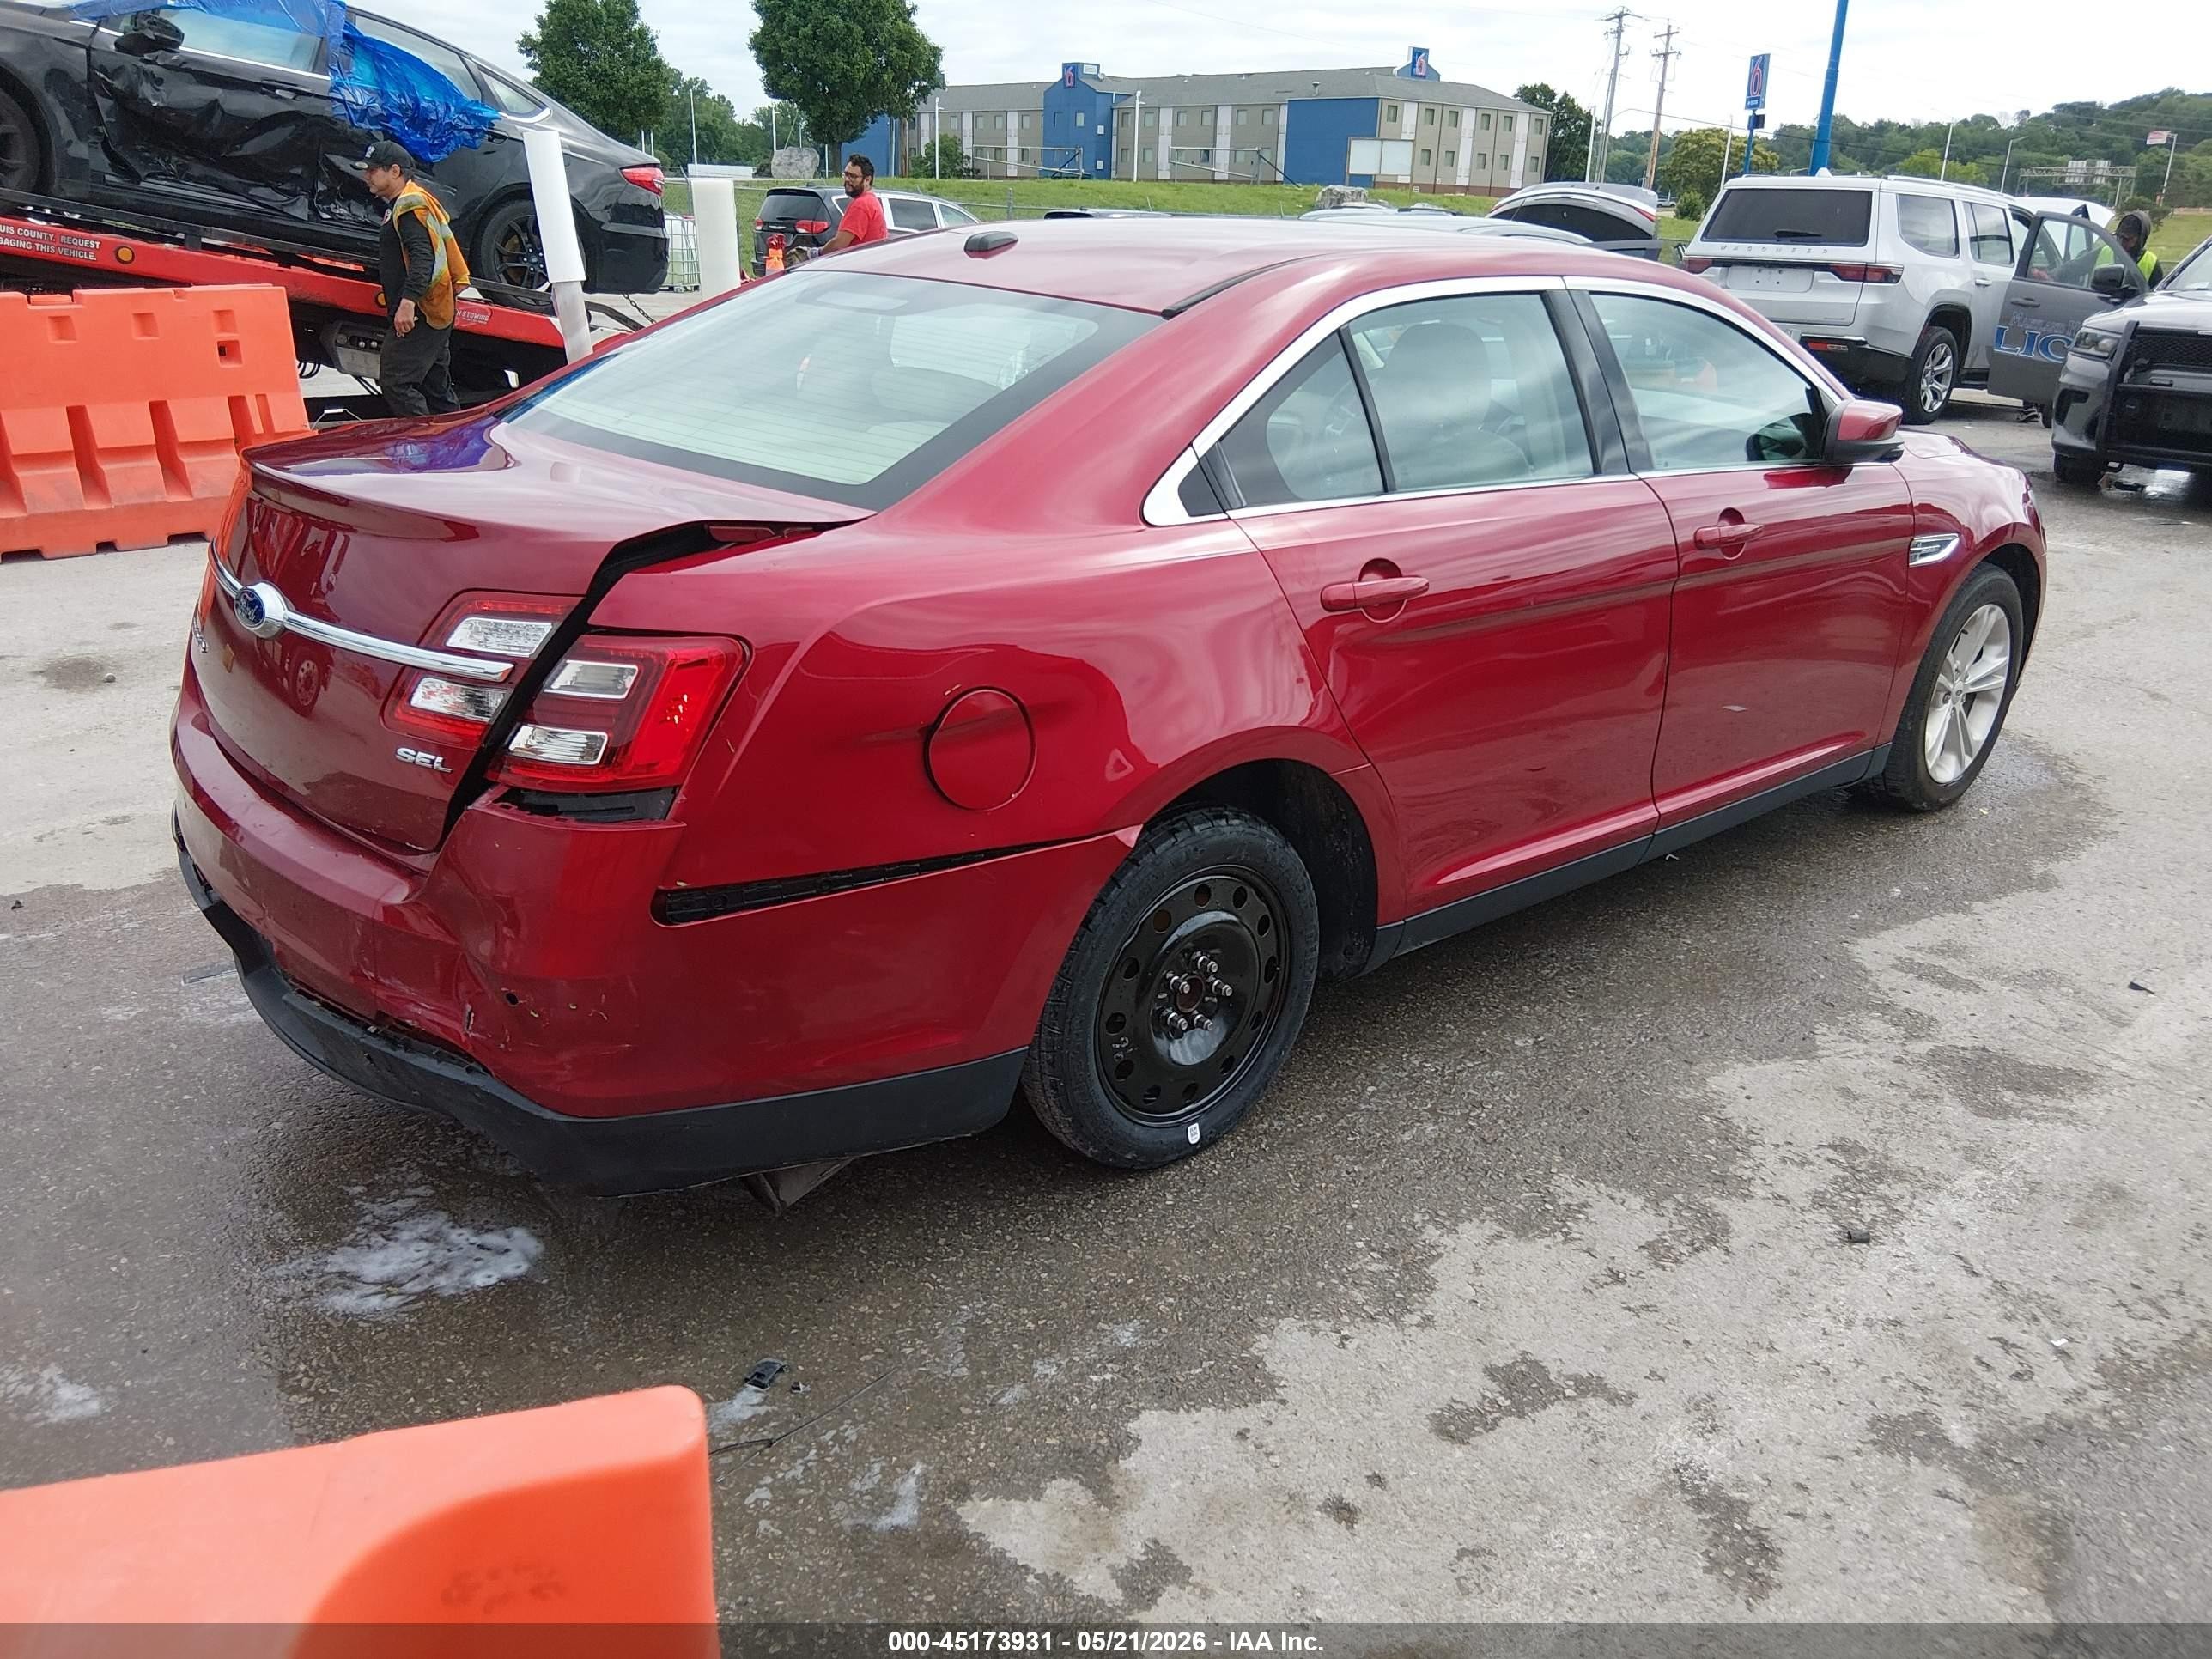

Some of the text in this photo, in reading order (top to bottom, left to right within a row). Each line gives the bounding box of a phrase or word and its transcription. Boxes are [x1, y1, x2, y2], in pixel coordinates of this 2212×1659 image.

[1416, 52, 1426, 76] 6
[1065, 65, 1073, 88] 6
[1749, 56, 1762, 96] 6
[17, 228, 56, 242] COUNTY.
[60, 235, 101, 249] REQUEST
[34, 243, 56, 254] THIS
[58, 247, 97, 261] VEHICLE.
[1720, 246, 1828, 255] WAGONEER
[396, 747, 453, 773] SEL
